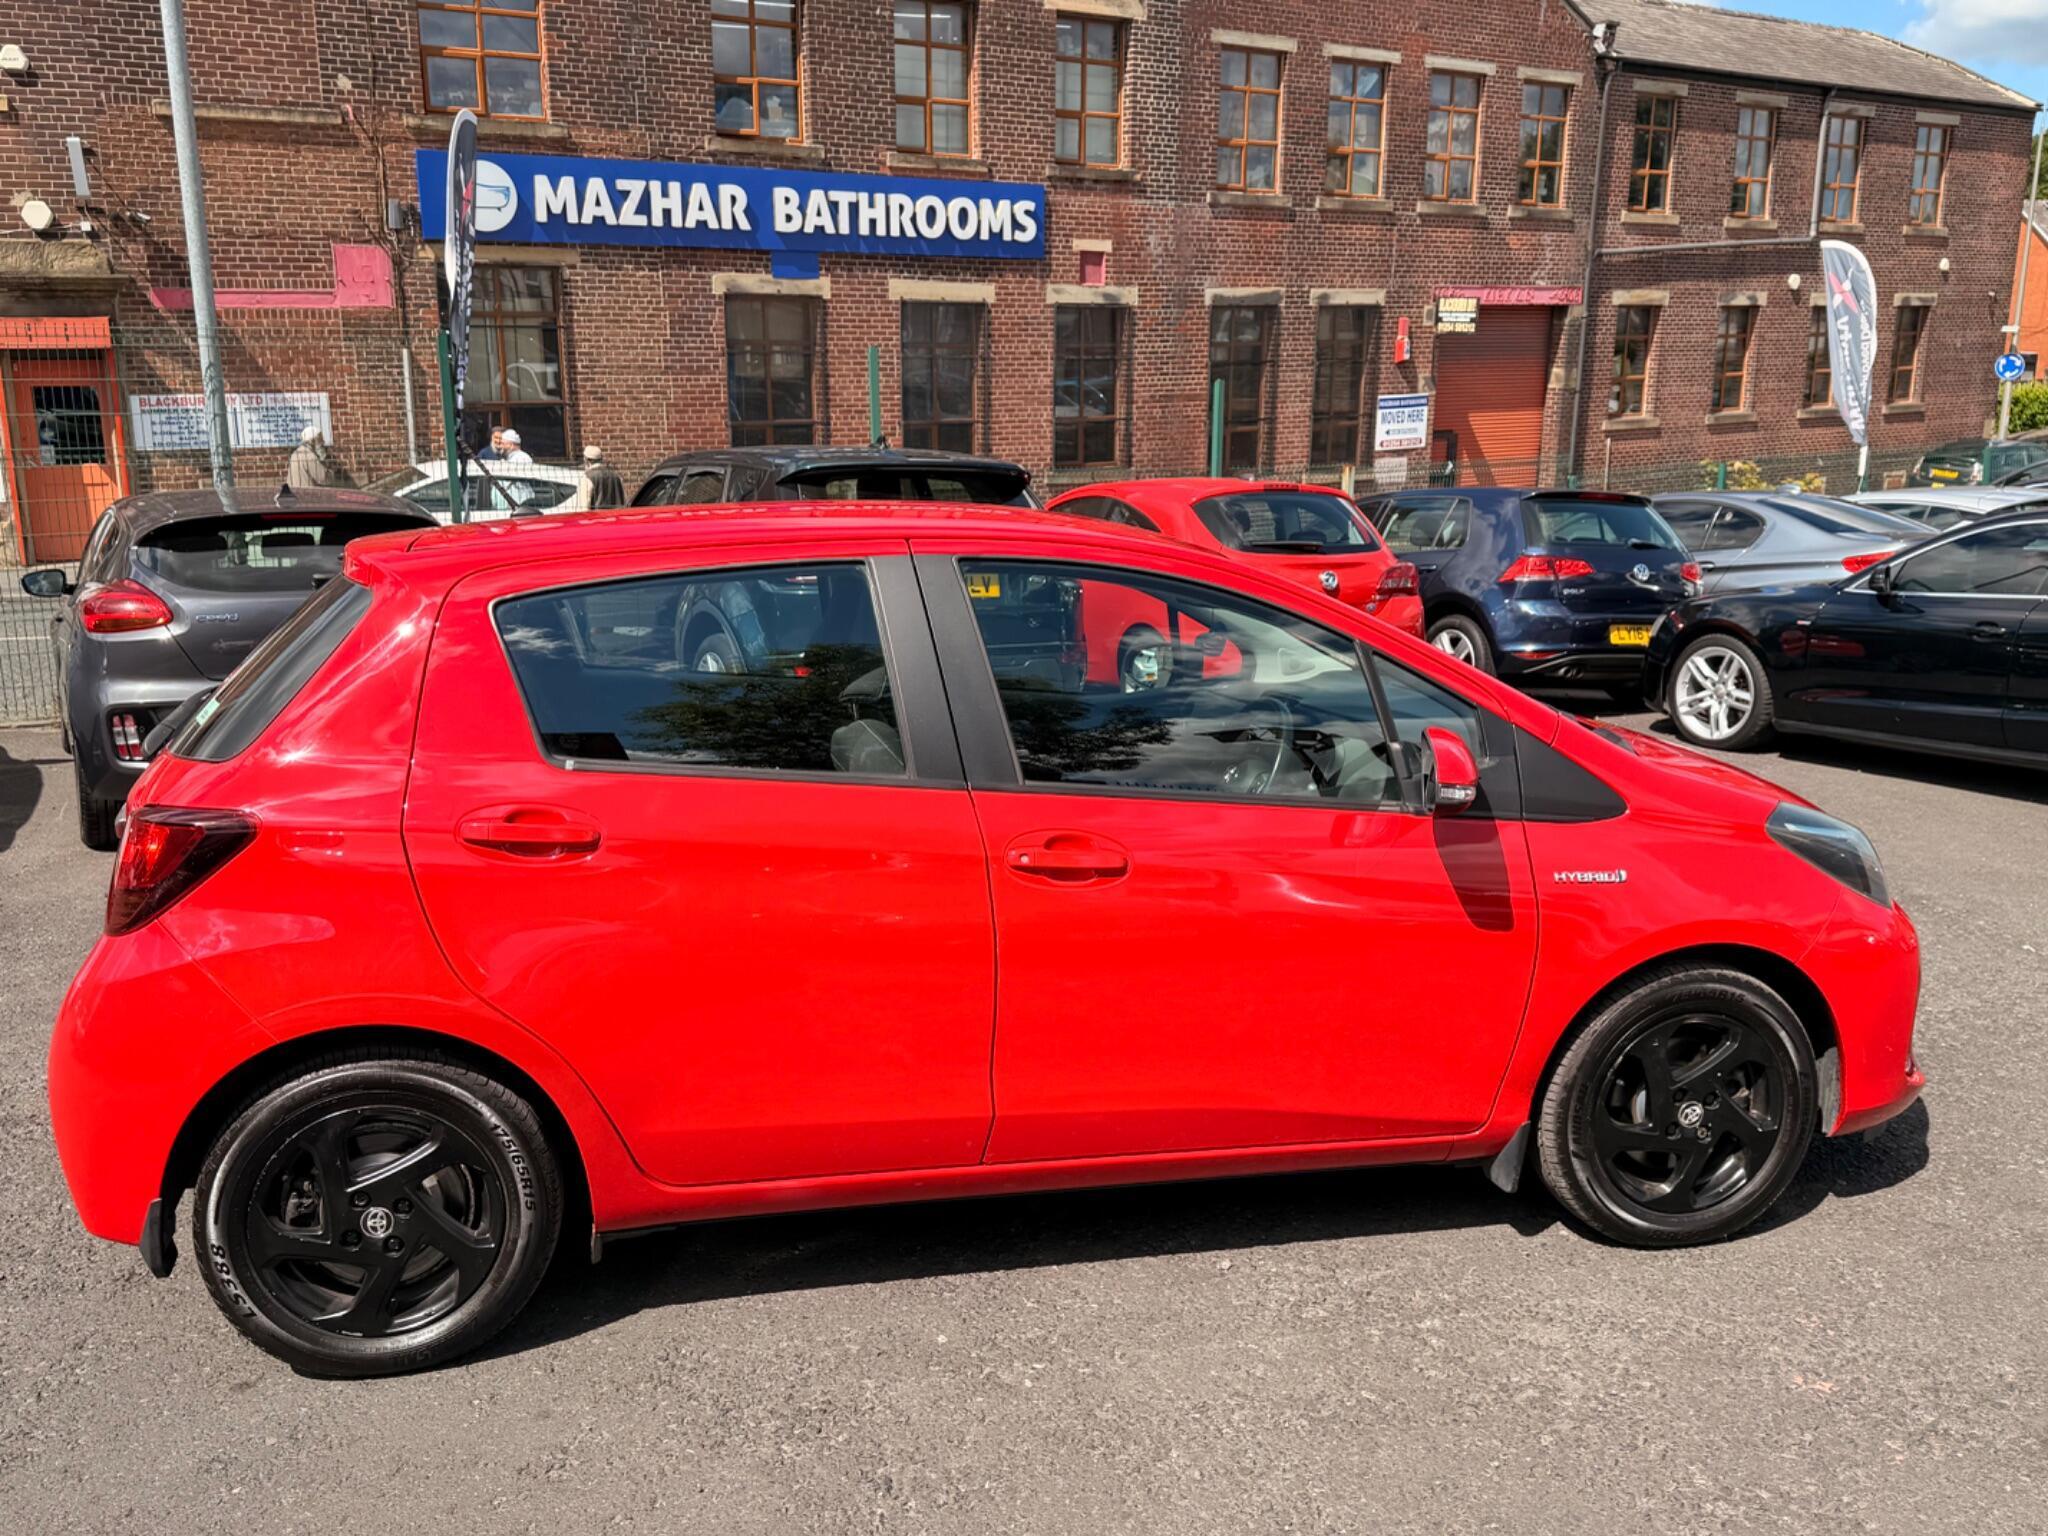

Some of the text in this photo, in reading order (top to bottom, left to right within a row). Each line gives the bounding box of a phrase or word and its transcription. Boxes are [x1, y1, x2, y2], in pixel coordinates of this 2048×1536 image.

[533, 174, 1037, 243] MAZHAR BATHROOMS
[139, 396, 205, 408] BLACKBUR
[241, 394, 263, 406] LTD
[1381, 409, 1424, 425] MOVED HERE
[1553, 871, 1616, 883] HYBRID
[489, 1123, 537, 1212] 175/65R15
[210, 1243, 258, 1318] LS388
